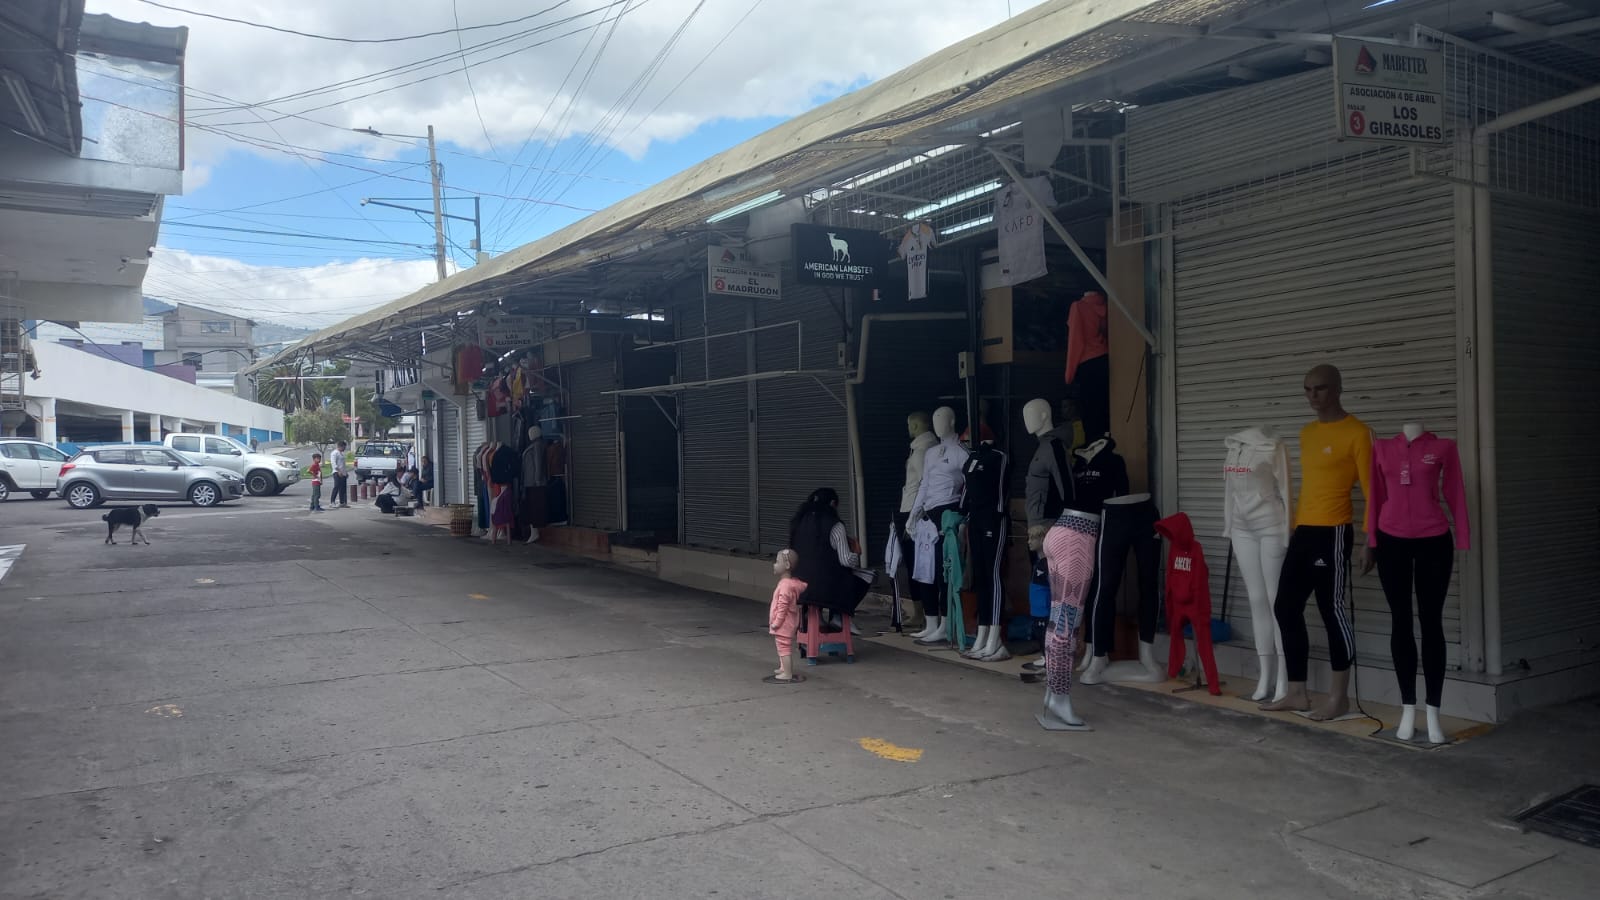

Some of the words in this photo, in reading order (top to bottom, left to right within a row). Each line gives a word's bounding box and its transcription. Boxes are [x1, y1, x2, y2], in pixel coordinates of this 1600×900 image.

[1382, 53, 1428, 74] MABETTEX
[1398, 91, 1402, 100] 4
[1404, 93, 1414, 102] DE
[1416, 94, 1436, 104] ABRIL
[1393, 106, 1418, 120] LOS
[1353, 116, 1361, 130] 3
[1370, 121, 1441, 139] GIRASOLES
[804, 261, 838, 272] AMERICAN
[839, 264, 873, 274] LAMBSTER
[748, 278, 759, 286] EL
